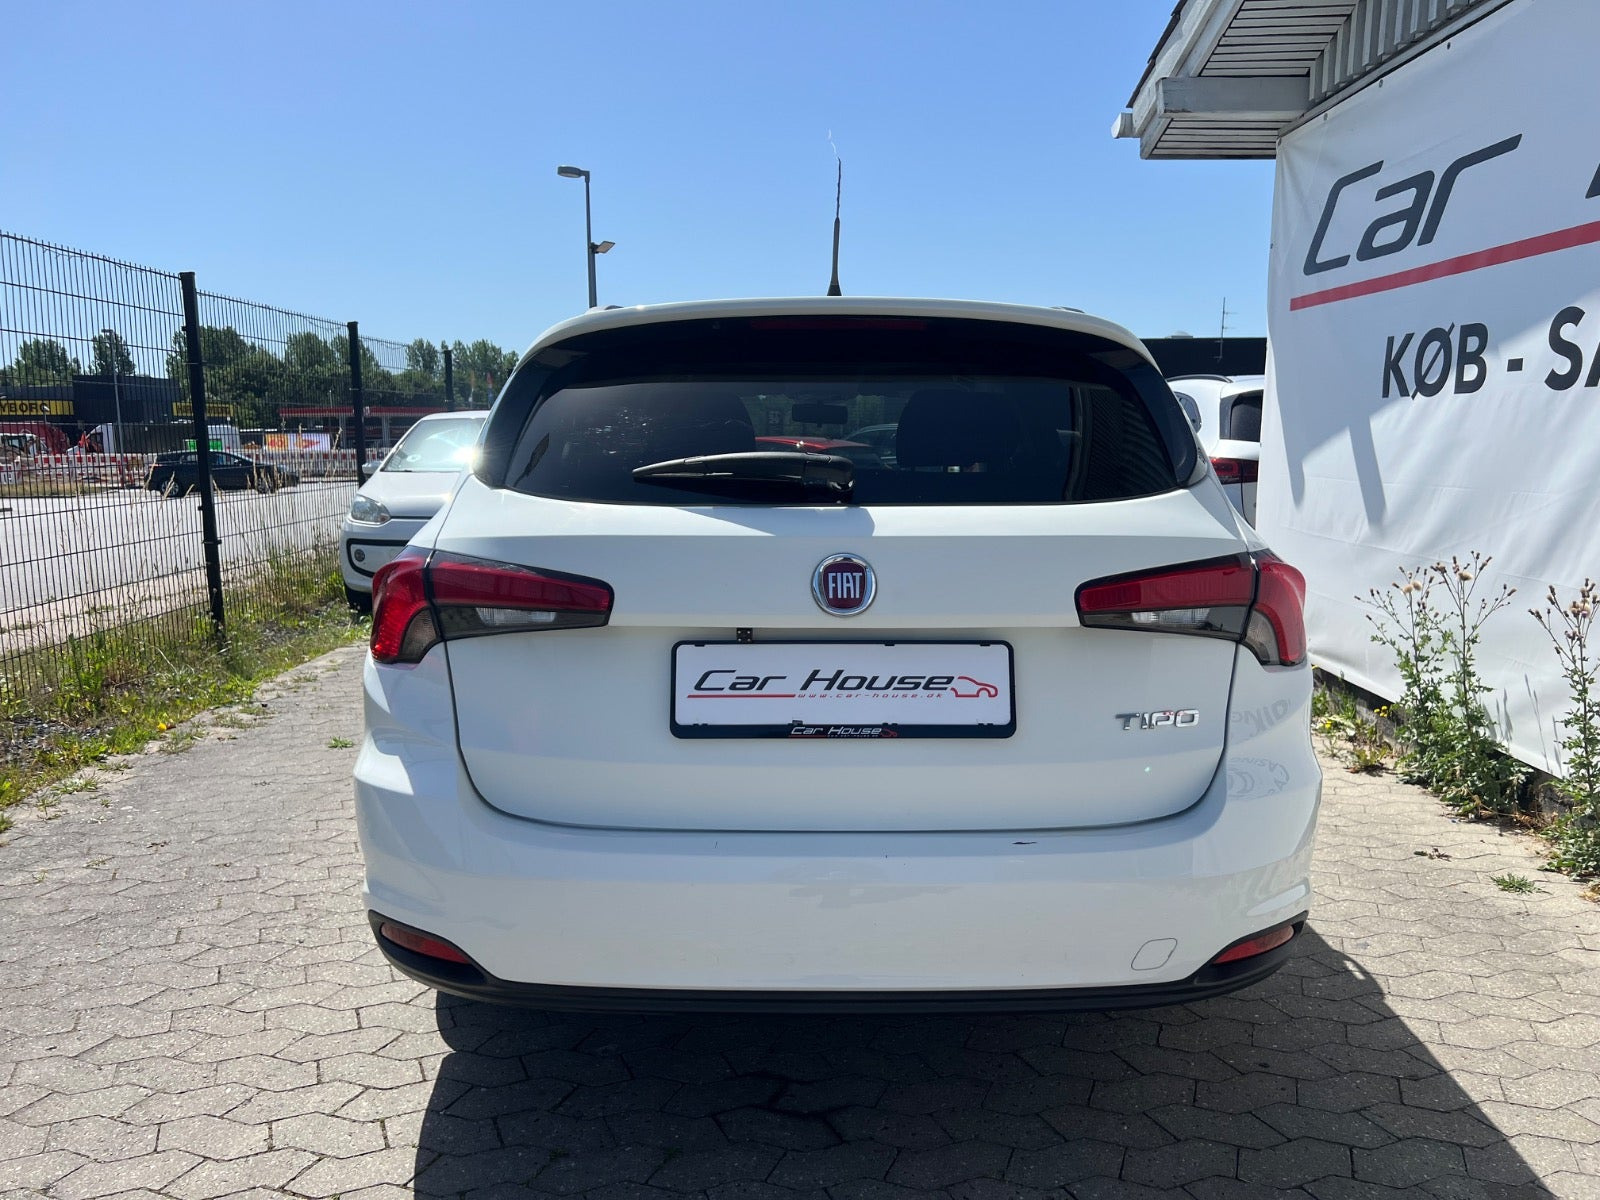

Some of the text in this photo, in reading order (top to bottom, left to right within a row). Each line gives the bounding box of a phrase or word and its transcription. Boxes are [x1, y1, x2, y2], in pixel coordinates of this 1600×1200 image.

[1303, 133, 1523, 276] Car
[1381, 321, 1489, 401] KØB
[828, 572, 863, 599] FIAT
[694, 669, 955, 691] Car House
[791, 726, 882, 735] Car House
[1115, 709, 1200, 730] TIPO
